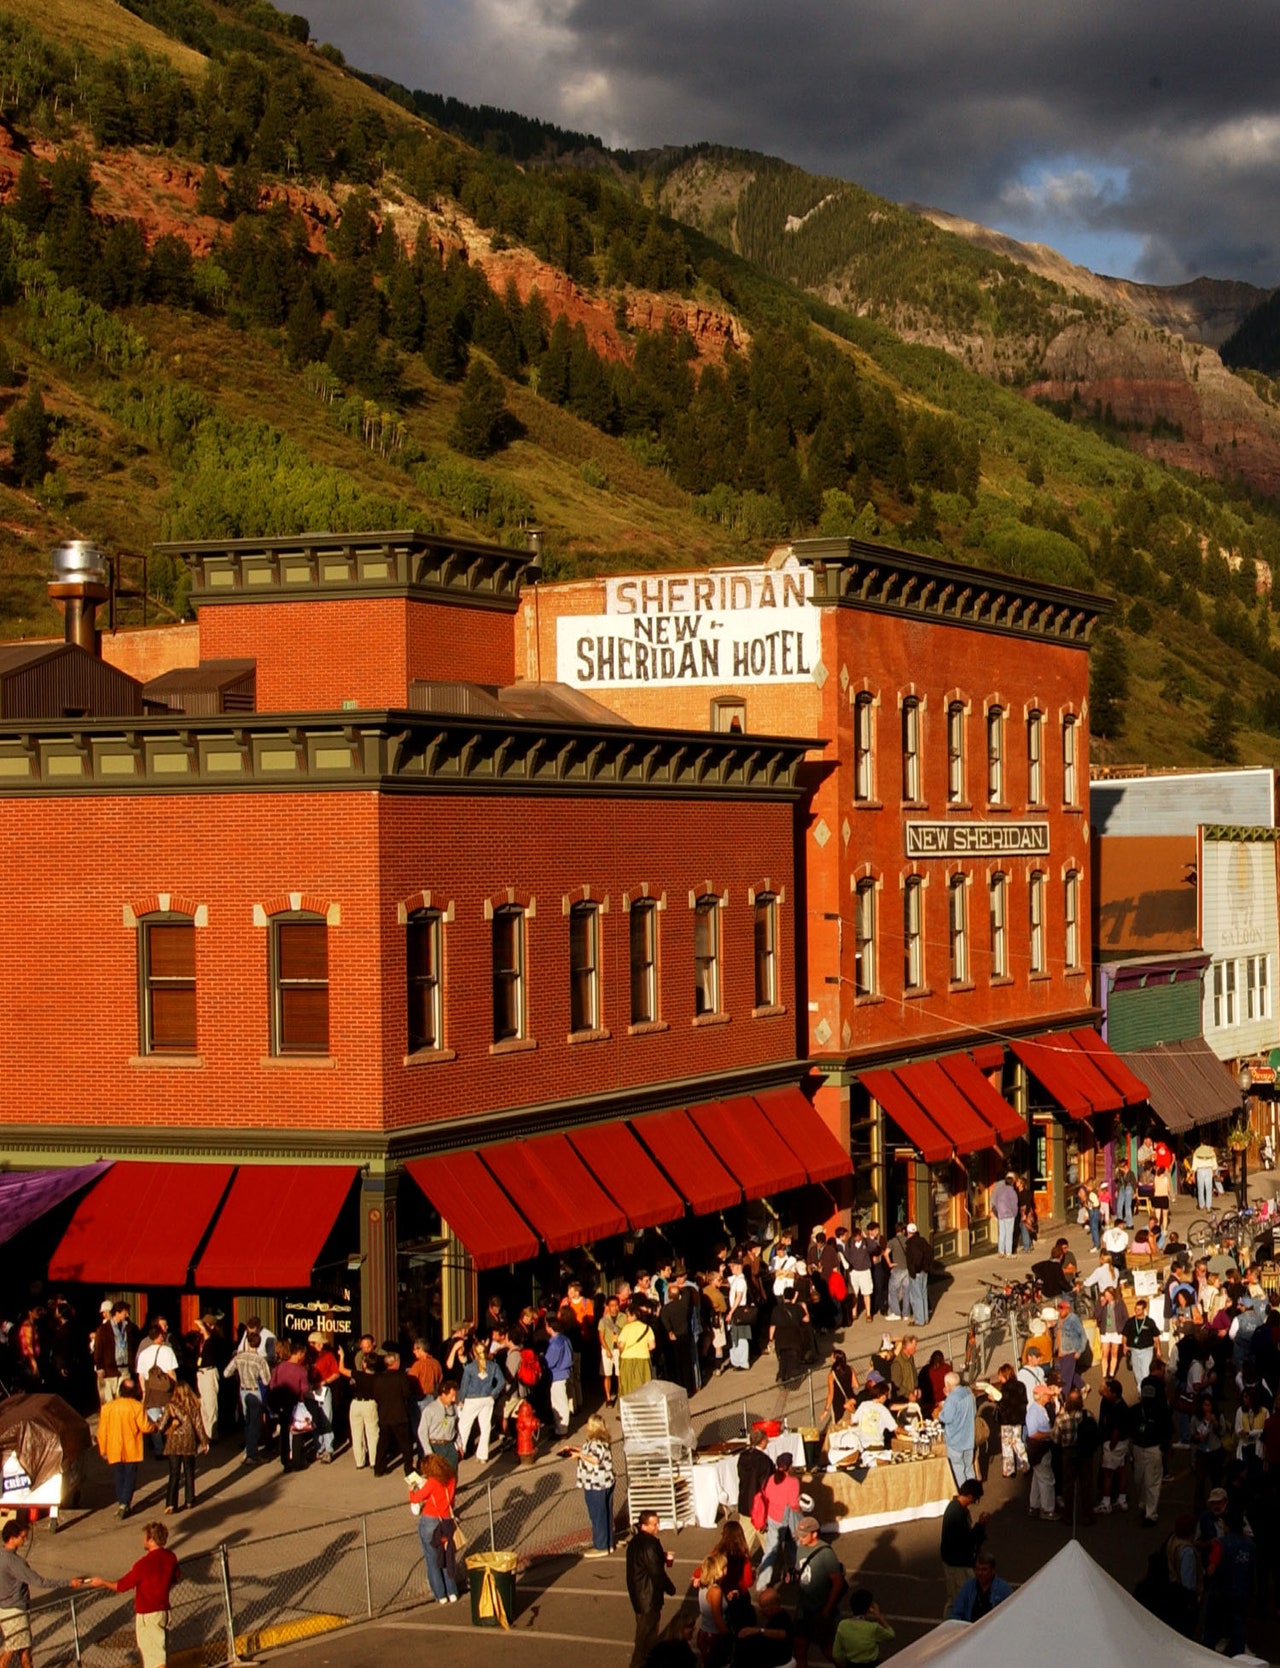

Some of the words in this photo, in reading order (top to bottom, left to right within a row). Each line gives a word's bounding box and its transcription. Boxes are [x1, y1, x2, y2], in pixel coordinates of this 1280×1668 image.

[616, 573, 806, 615] SHERIDAN
[633, 615, 703, 645] NEW
[576, 635, 720, 682] SHERIDAN
[732, 629, 811, 677] HOTEL
[909, 827, 949, 850] NEW
[1221, 927, 1263, 946] SALOON
[285, 1313, 315, 1331] CHOP
[316, 1314, 352, 1333] HOUSE
